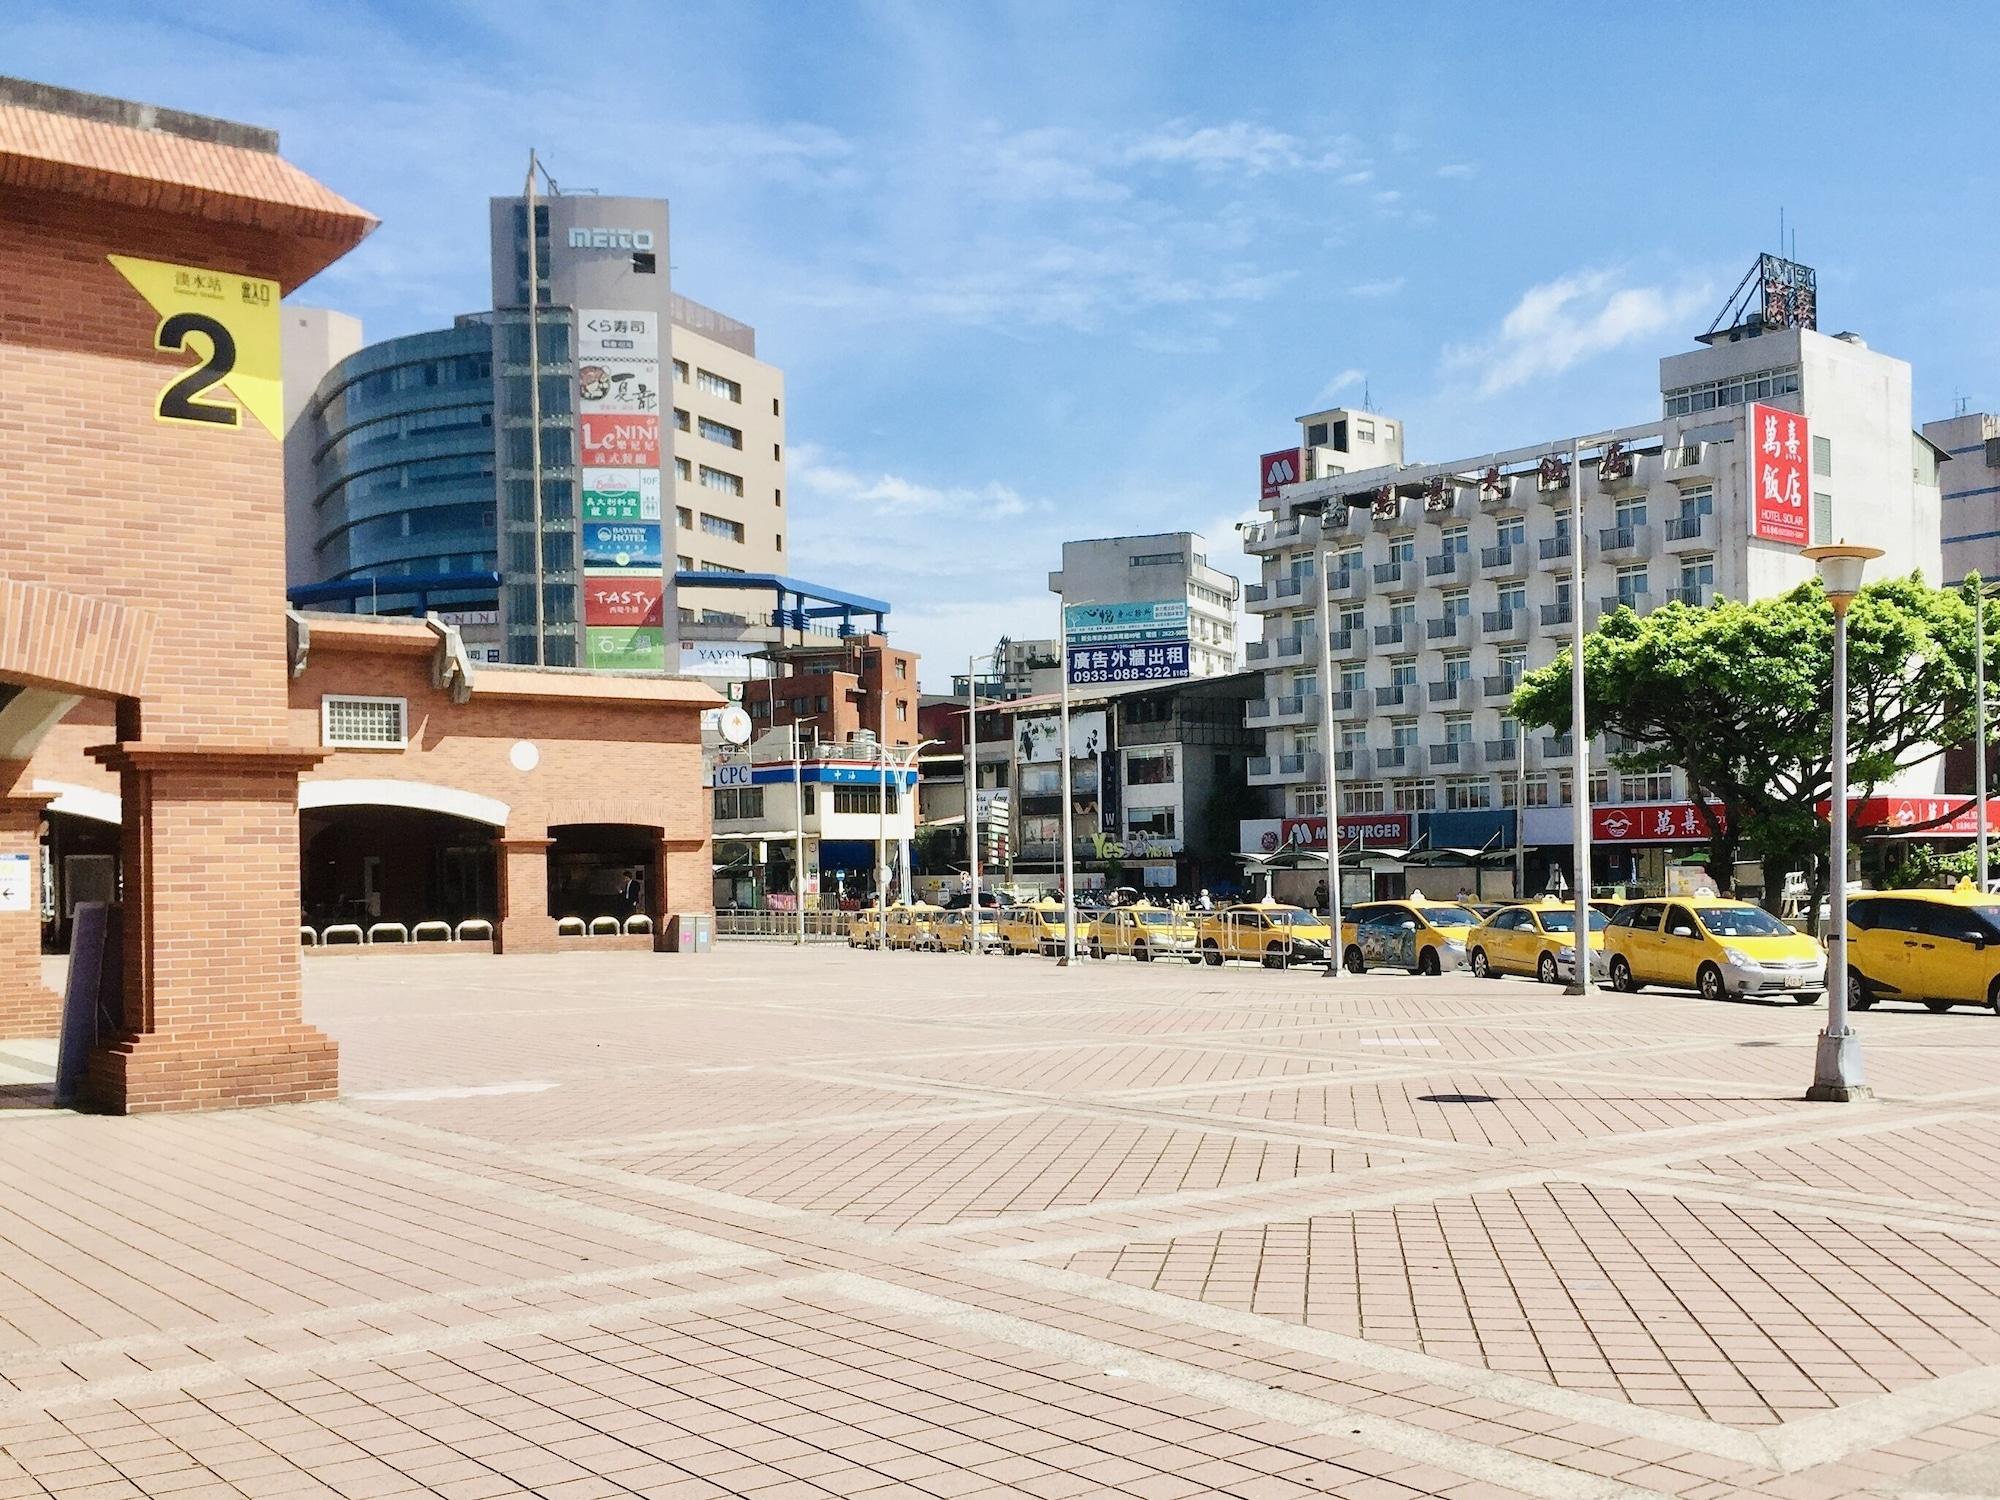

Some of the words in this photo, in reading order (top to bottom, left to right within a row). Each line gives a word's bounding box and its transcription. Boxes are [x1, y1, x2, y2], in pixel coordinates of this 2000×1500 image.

[586, 319, 645, 334] くら寿司
[158, 312, 237, 426] 2
[614, 424, 658, 441] NINI
[1761, 462, 1803, 507] 飯店
[1760, 508, 1782, 523] HOTEL
[1782, 512, 1804, 526] SOLAR
[612, 527, 647, 535] BAYVIEW
[612, 533, 648, 542] HOTEL
[1073, 666, 1171, 683] 0933-088-322
[720, 765, 748, 785] CPC
[834, 769, 856, 781] 中油
[1315, 825, 1345, 840] MS
[1348, 823, 1401, 839] BURGER
[1091, 832, 1124, 860] Yes
